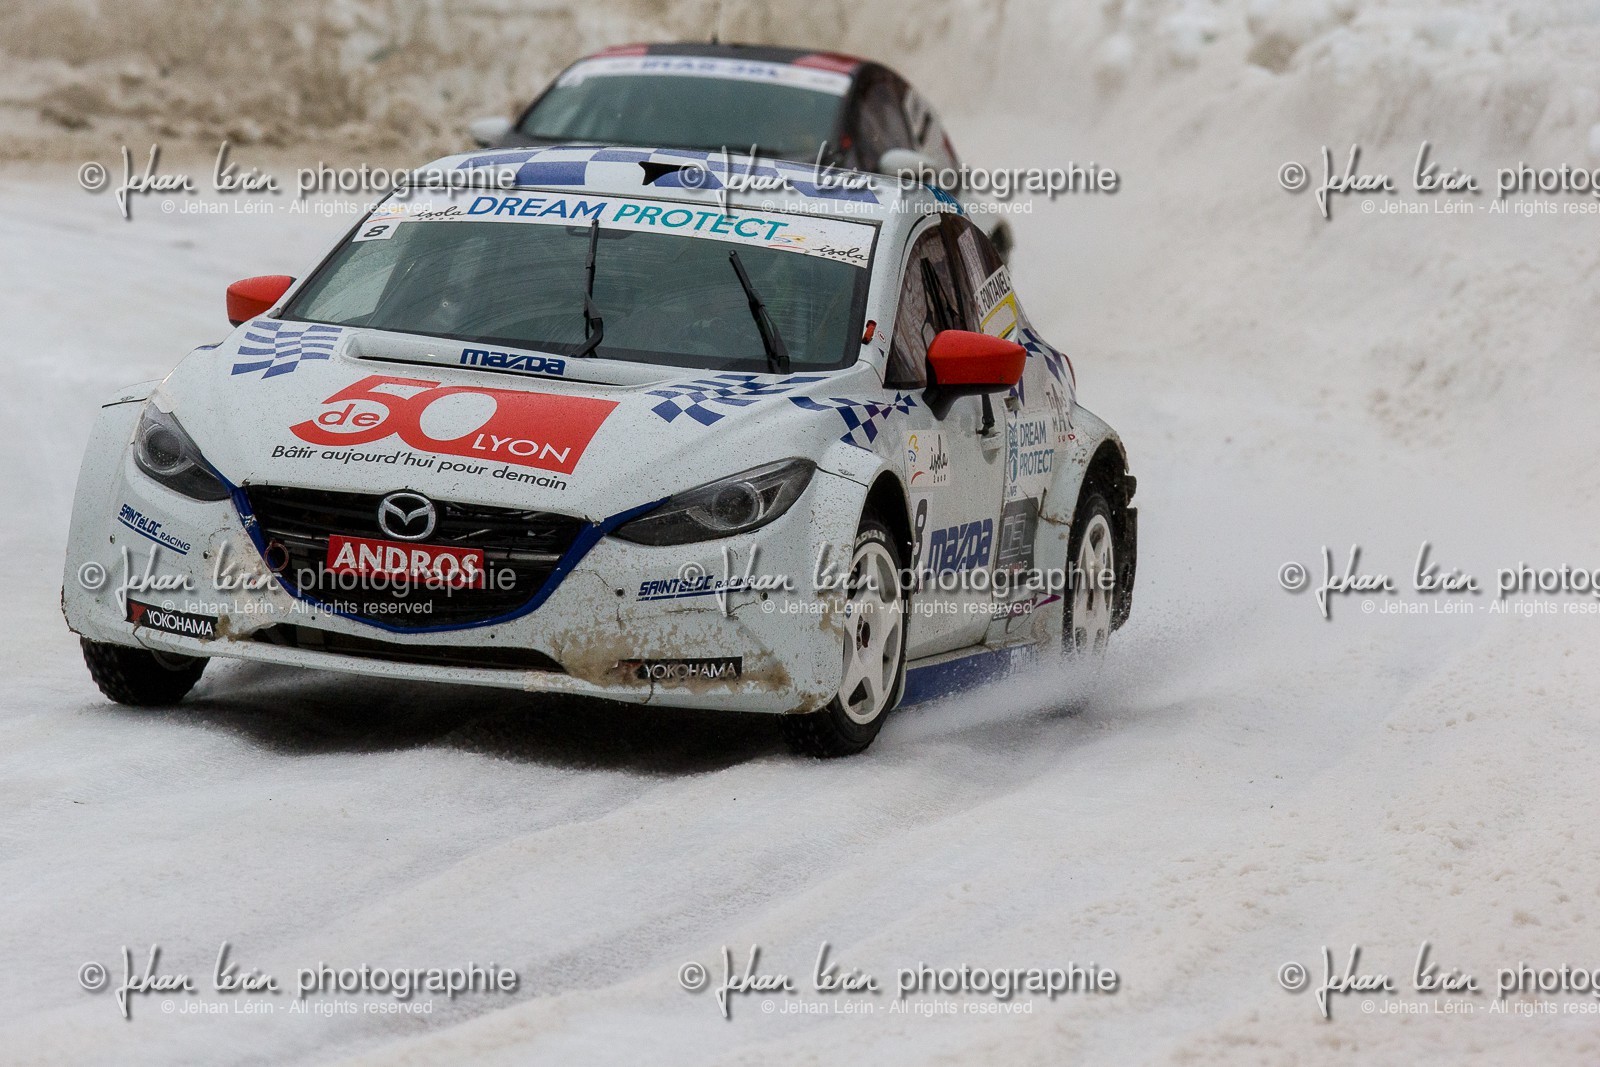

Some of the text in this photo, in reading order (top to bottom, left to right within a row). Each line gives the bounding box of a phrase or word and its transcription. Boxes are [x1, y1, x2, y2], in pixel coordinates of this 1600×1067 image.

[363, 225, 390, 238] 8
[467, 196, 789, 241] DREAM PROTECT
[812, 245, 869, 261] isola
[317, 403, 381, 427] de
[1020, 420, 1047, 447] DREAM
[472, 433, 572, 464] LYON
[271, 445, 567, 490] Bâtir aujourd'hui pour demain
[1020, 449, 1055, 477] PROTECT
[159, 531, 191, 551] RACING
[333, 542, 479, 583] ANDROS
[147, 609, 213, 636] YOKOHAMA
[646, 662, 737, 679] YOKOHAMA
